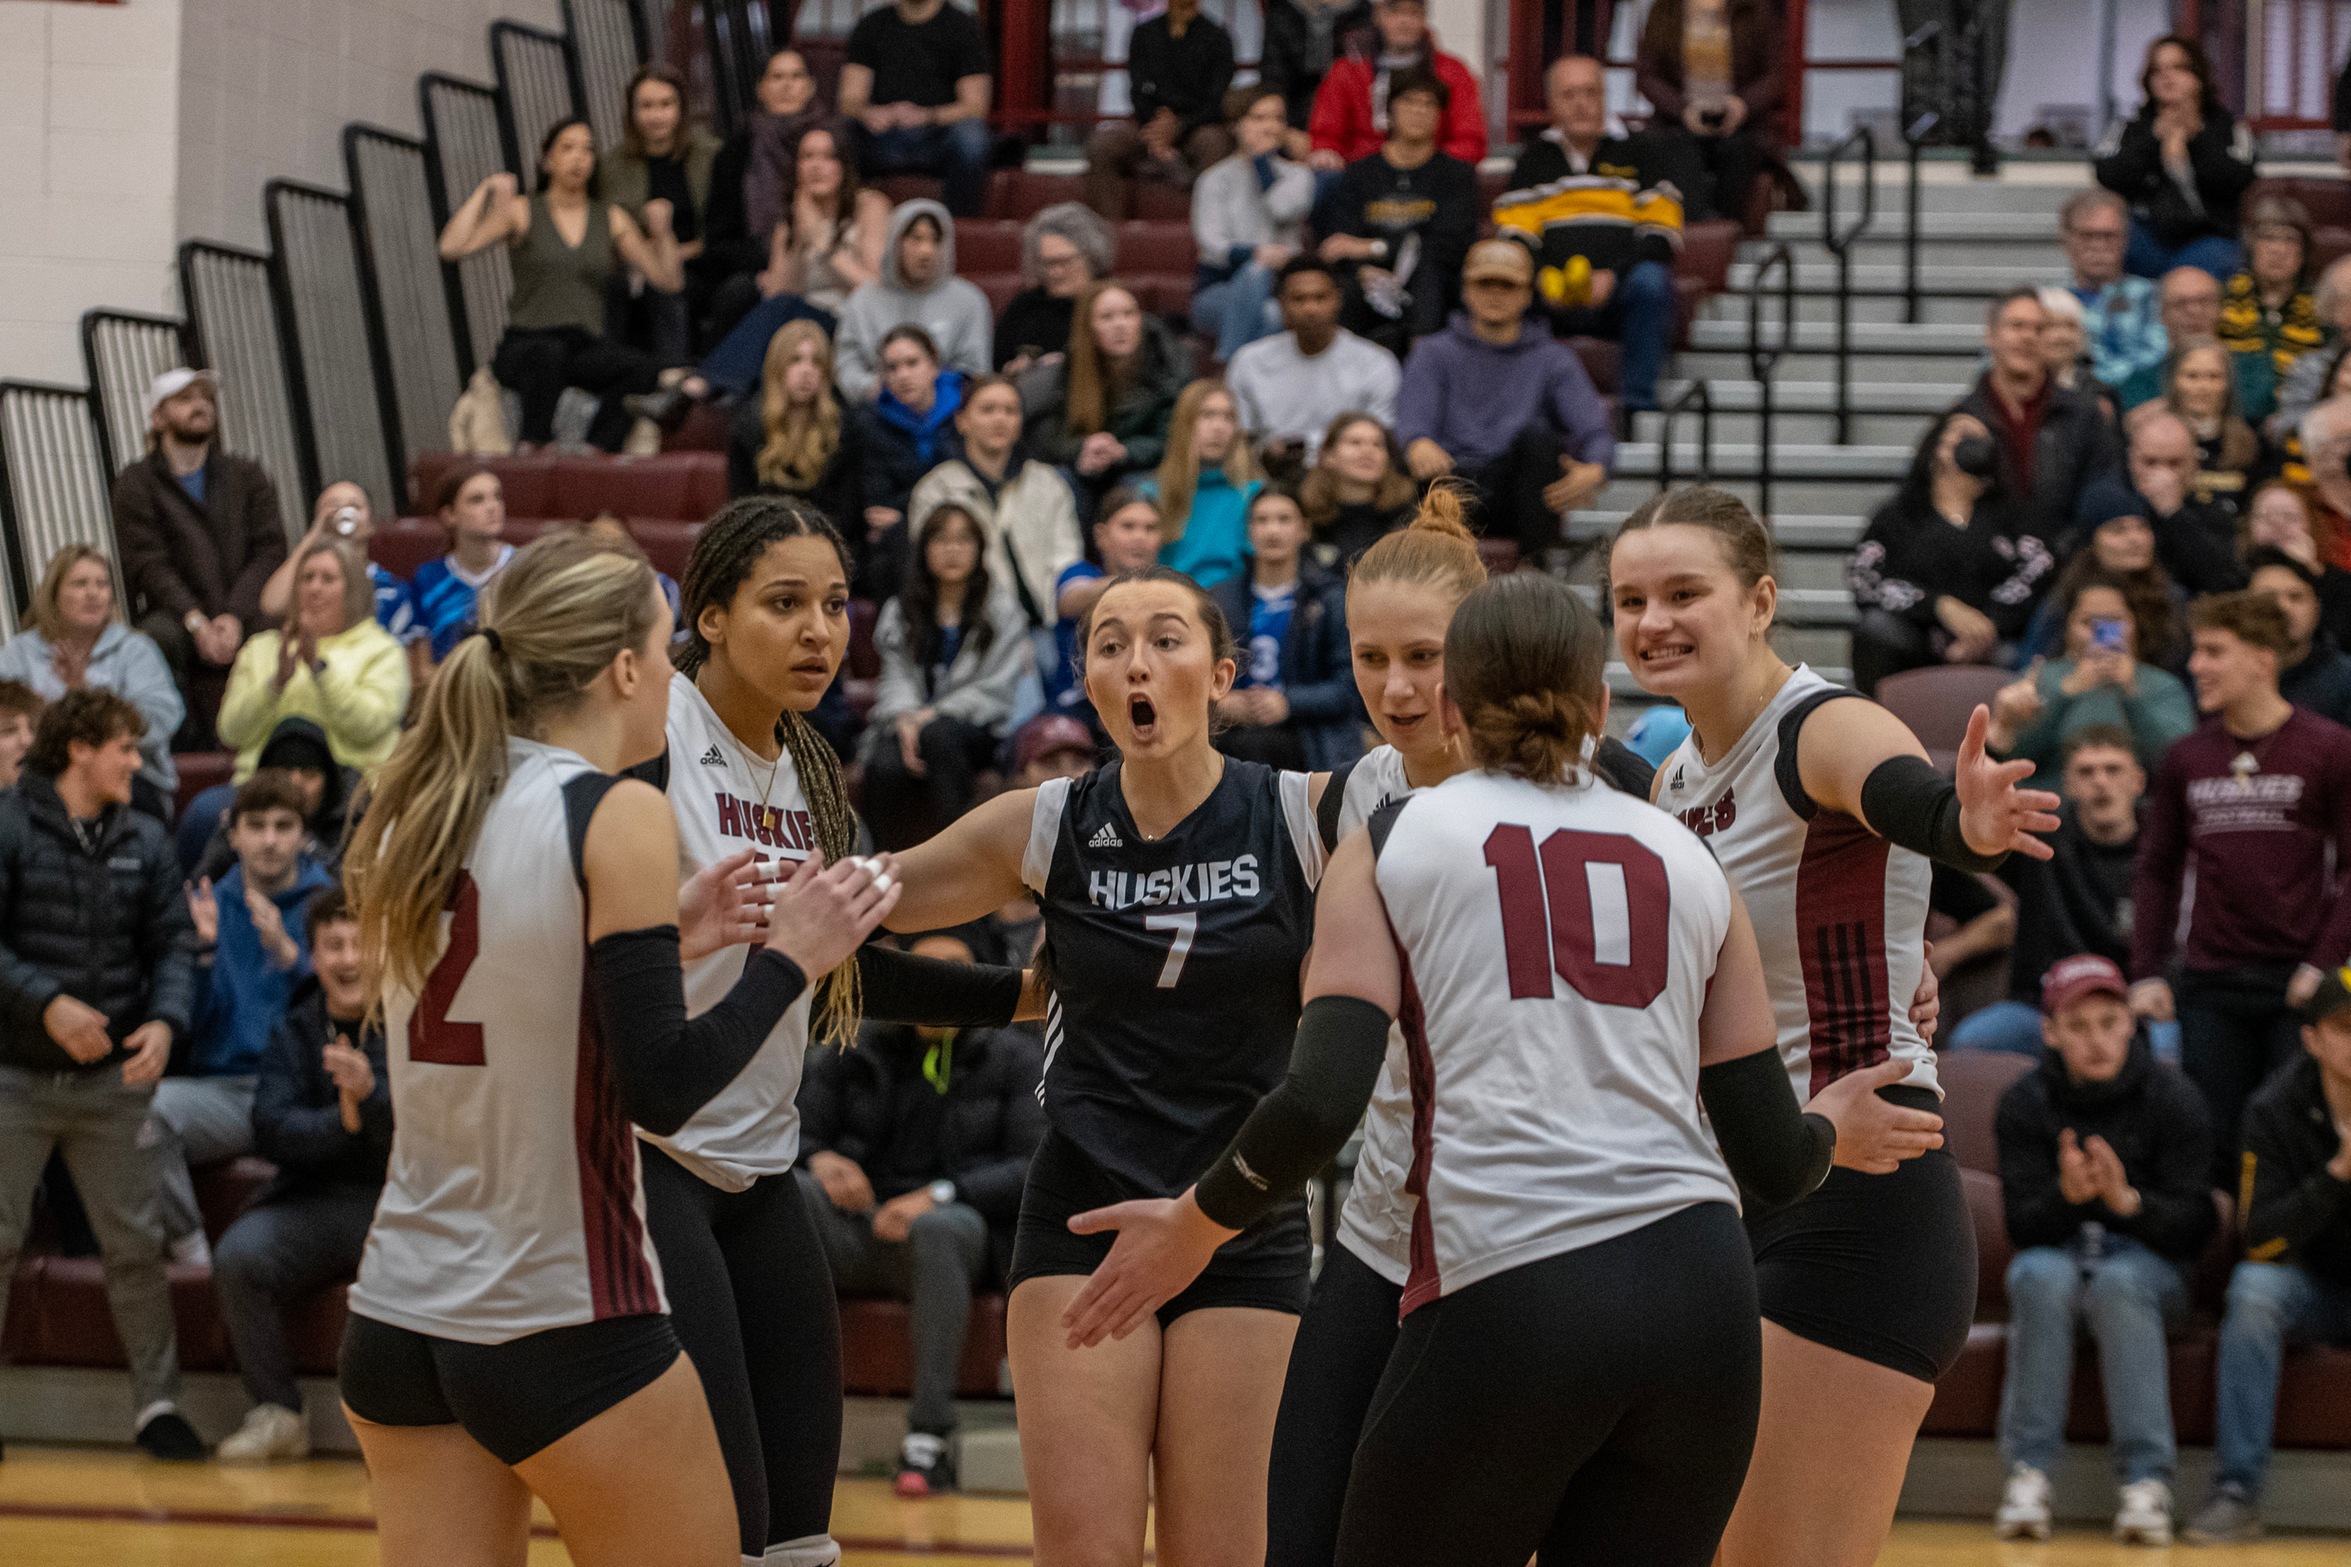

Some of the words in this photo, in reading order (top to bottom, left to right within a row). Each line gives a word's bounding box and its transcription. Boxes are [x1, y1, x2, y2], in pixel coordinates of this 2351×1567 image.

[715, 792, 816, 850] HUSKIE
[1088, 836, 1123, 848] adidas
[1088, 853, 1260, 911] HUSKIES
[1483, 822, 1671, 1010] 10
[408, 868, 487, 1067] 2
[1143, 911, 1198, 989] 7
